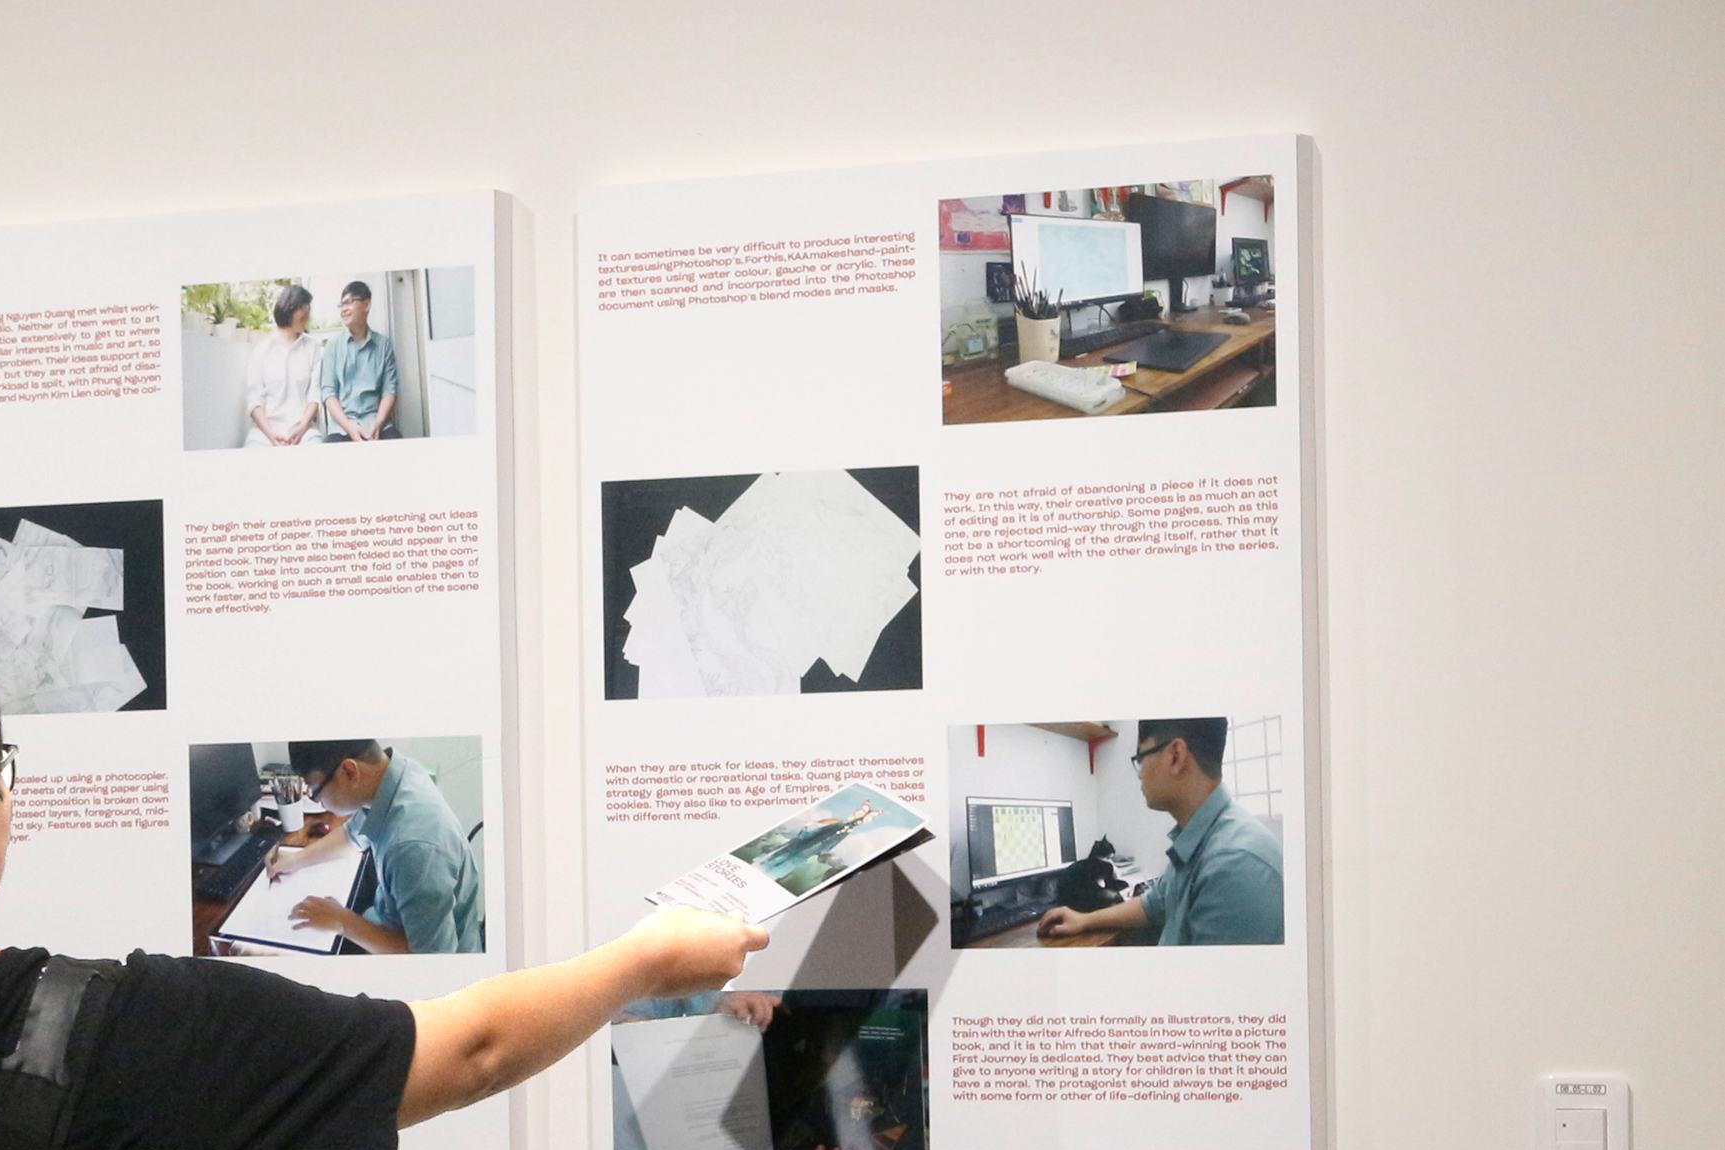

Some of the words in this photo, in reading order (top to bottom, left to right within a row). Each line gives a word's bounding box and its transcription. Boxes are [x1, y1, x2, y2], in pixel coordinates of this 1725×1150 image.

[598, 253, 607, 261] It
[634, 247, 695, 258] sometimes
[698, 245, 712, 254] be
[715, 245, 740, 255] very
[742, 240, 786, 251] difficult
[788, 239, 801, 248] to
[803, 236, 851, 249] produce
[853, 231, 915, 245] interesting
[598, 299, 654, 310] document
[656, 297, 686, 308] using
[758, 290, 790, 299] blend
[792, 287, 831, 297] modes
[834, 285, 855, 294] and
[943, 491, 970, 502] They
[975, 491, 994, 499] are
[998, 489, 1018, 497] not
[1022, 487, 1056, 496] afraid
[1060, 486, 1072, 494] of
[1077, 482, 1145, 495] abandoning
[1161, 480, 1194, 491] piece
[1198, 479, 1206, 487] if
[1210, 478, 1219, 487] it
[1223, 476, 1253, 486] does
[1257, 475, 1278, 484] not
[184, 523, 208, 533] They
[211, 521, 239, 532] begin
[242, 520, 266, 528] their
[269, 518, 311, 527] creative
[314, 517, 357, 527] process
[359, 515, 373, 524] by
[375, 512, 426, 524] sketching
[428, 511, 446, 519] out
[449, 509, 478, 518] ideas
[994, 525, 1043, 537] rejected
[1099, 520, 1145, 532] through
[1148, 519, 1168, 528] the
[1226, 515, 1250, 524] This
[1252, 515, 1278, 525] may
[185, 547, 202, 555] the
[237, 543, 292, 554] proportion
[311, 541, 328, 549] the
[331, 539, 369, 550] images
[372, 537, 403, 546] would
[406, 537, 444, 546] appear
[447, 534, 457, 542] in
[460, 533, 478, 542] the
[959, 566, 984, 575] with
[987, 565, 1006, 573] the
[605, 764, 636, 772] When
[639, 763, 665, 773] they
[690, 761, 721, 770] stuck
[725, 761, 741, 769] for
[781, 759, 807, 769] they
[810, 758, 854, 767] distract
[858, 756, 924, 765] themselves
[50, 776, 63, 784] up
[66, 774, 93, 783] using
[605, 788, 652, 798] strategy
[655, 788, 693, 797] games
[696, 786, 723, 794] such
[744, 785, 765, 795] Age
[769, 784, 781, 792] of
[890, 782, 925, 791] bakes
[28, 797, 90, 807] composition
[92, 796, 101, 804] is
[103, 795, 139, 804] broken
[141, 795, 169, 803] down
[606, 813, 630, 821] with
[632, 811, 680, 820] different
[714, 857, 741, 873] LOVE
[705, 863, 748, 889] STORIES
[952, 1016, 993, 1026] Though
[996, 1016, 1022, 1026] they
[1026, 1016, 1044, 1024] did
[1046, 1016, 1066, 1024] not
[1069, 1016, 1096, 1024] train
[1099, 1015, 1147, 1025] formally
[1237, 1014, 1264, 1024] they
[1267, 1014, 1286, 1022] did
[988, 1041, 1010, 1049] and
[1013, 1041, 1022, 1049] it
[1025, 1041, 1035, 1049] is
[1039, 1041, 1051, 1049] to
[1055, 1041, 1076, 1049] him
[1080, 1041, 1104, 1049] that
[1108, 1041, 1136, 1049] their
[1230, 1040, 1260, 1048] book
[1264, 1040, 1286, 1048] The
[1015, 1091, 1042, 1099] form
[1060, 1091, 1092, 1099] other
[1094, 1091, 1106, 1099] of
